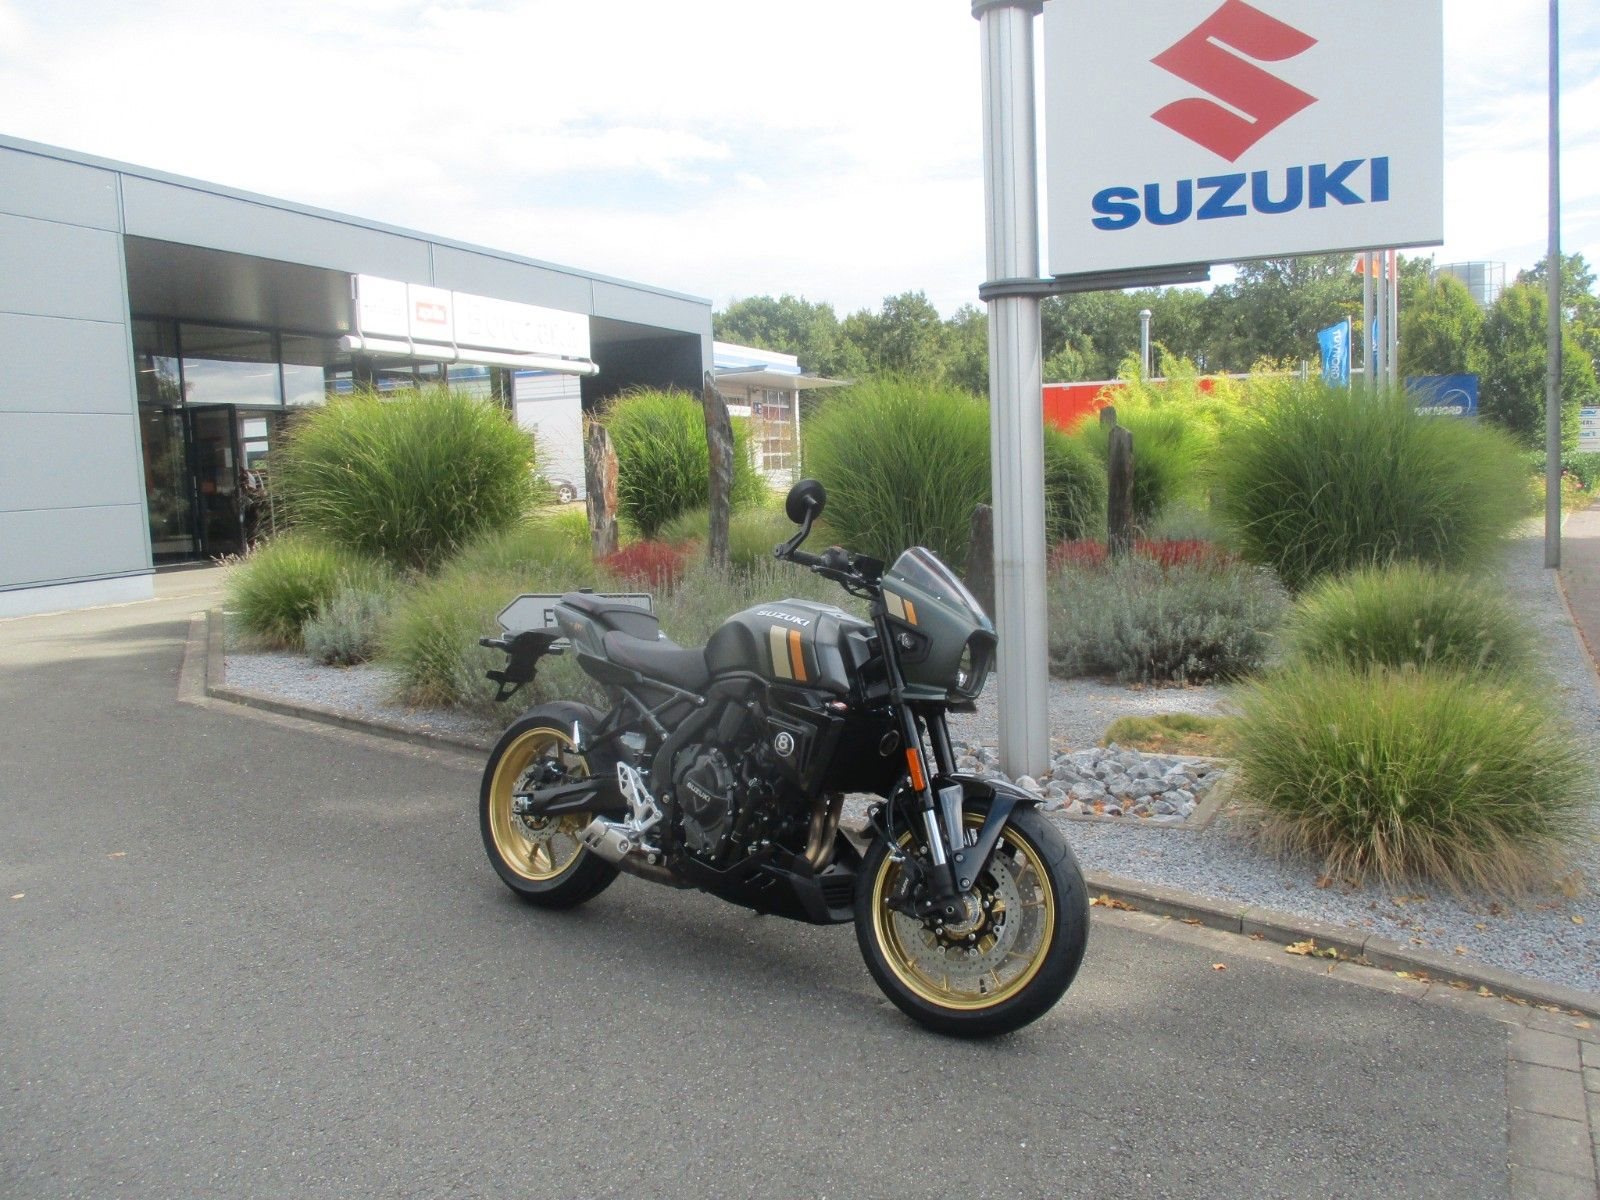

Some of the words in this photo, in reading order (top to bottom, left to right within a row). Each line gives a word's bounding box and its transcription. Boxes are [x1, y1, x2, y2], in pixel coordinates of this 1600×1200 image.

[1091, 156, 1389, 231] SUZUKI
[757, 610, 810, 627] SUZUKI
[687, 782, 710, 802] SUZUKI
